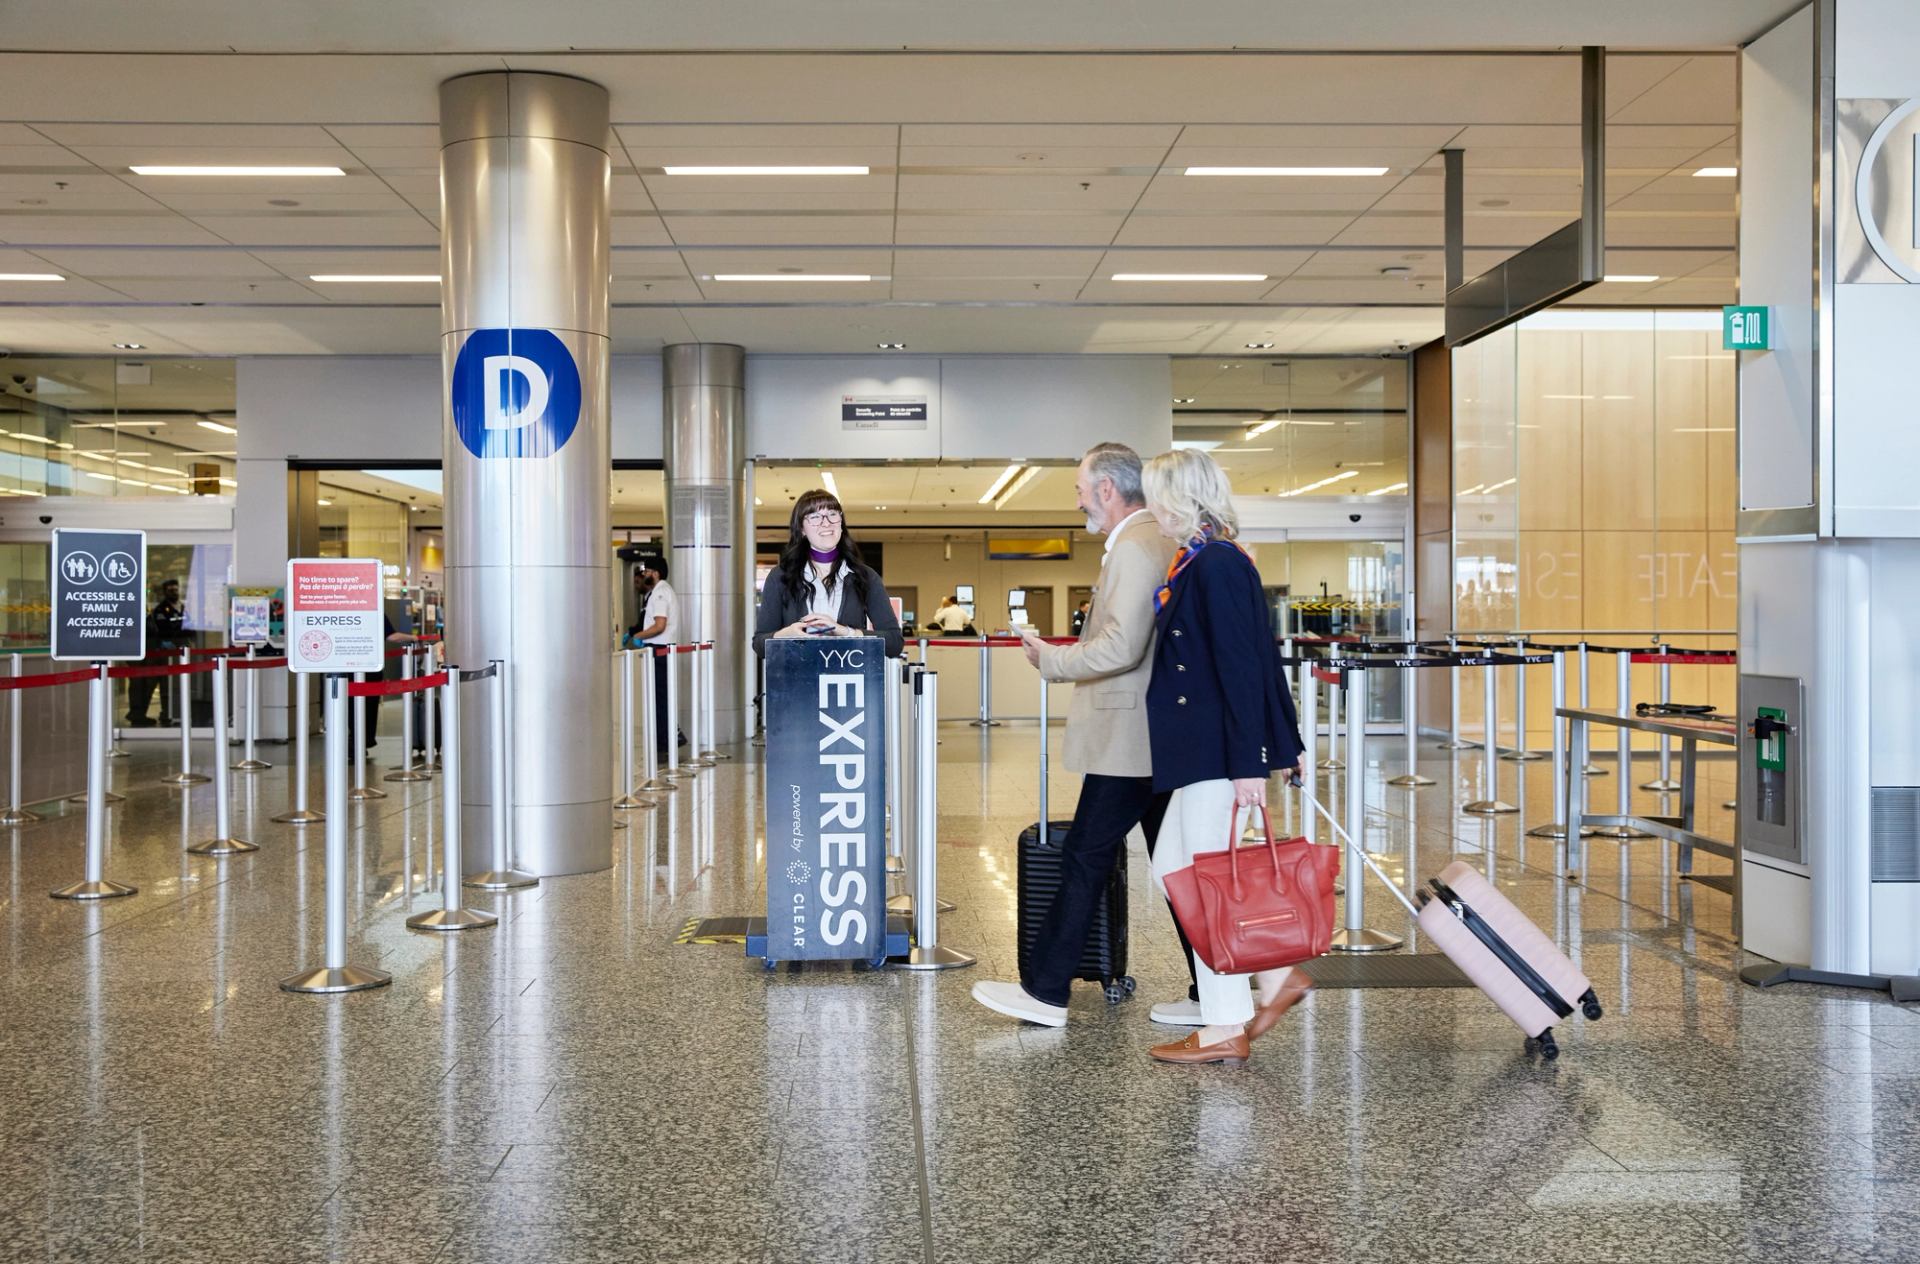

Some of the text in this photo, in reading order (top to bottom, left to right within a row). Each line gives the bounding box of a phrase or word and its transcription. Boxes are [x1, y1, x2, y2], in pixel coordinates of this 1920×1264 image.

[484, 355, 549, 429] D
[336, 576, 359, 585] spare?
[65, 592, 135, 601] ACCESSIBLE &
[82, 603, 118, 612] FAMILY
[66, 617, 134, 626] ACCESSIBLE &
[307, 616, 361, 626] EXPRESS
[80, 629, 121, 638] FAMILLE
[819, 649, 864, 668] YYC
[819, 674, 867, 946] EXPRESS
[790, 785, 804, 853] powered by
[793, 893, 805, 947] CLEAR
